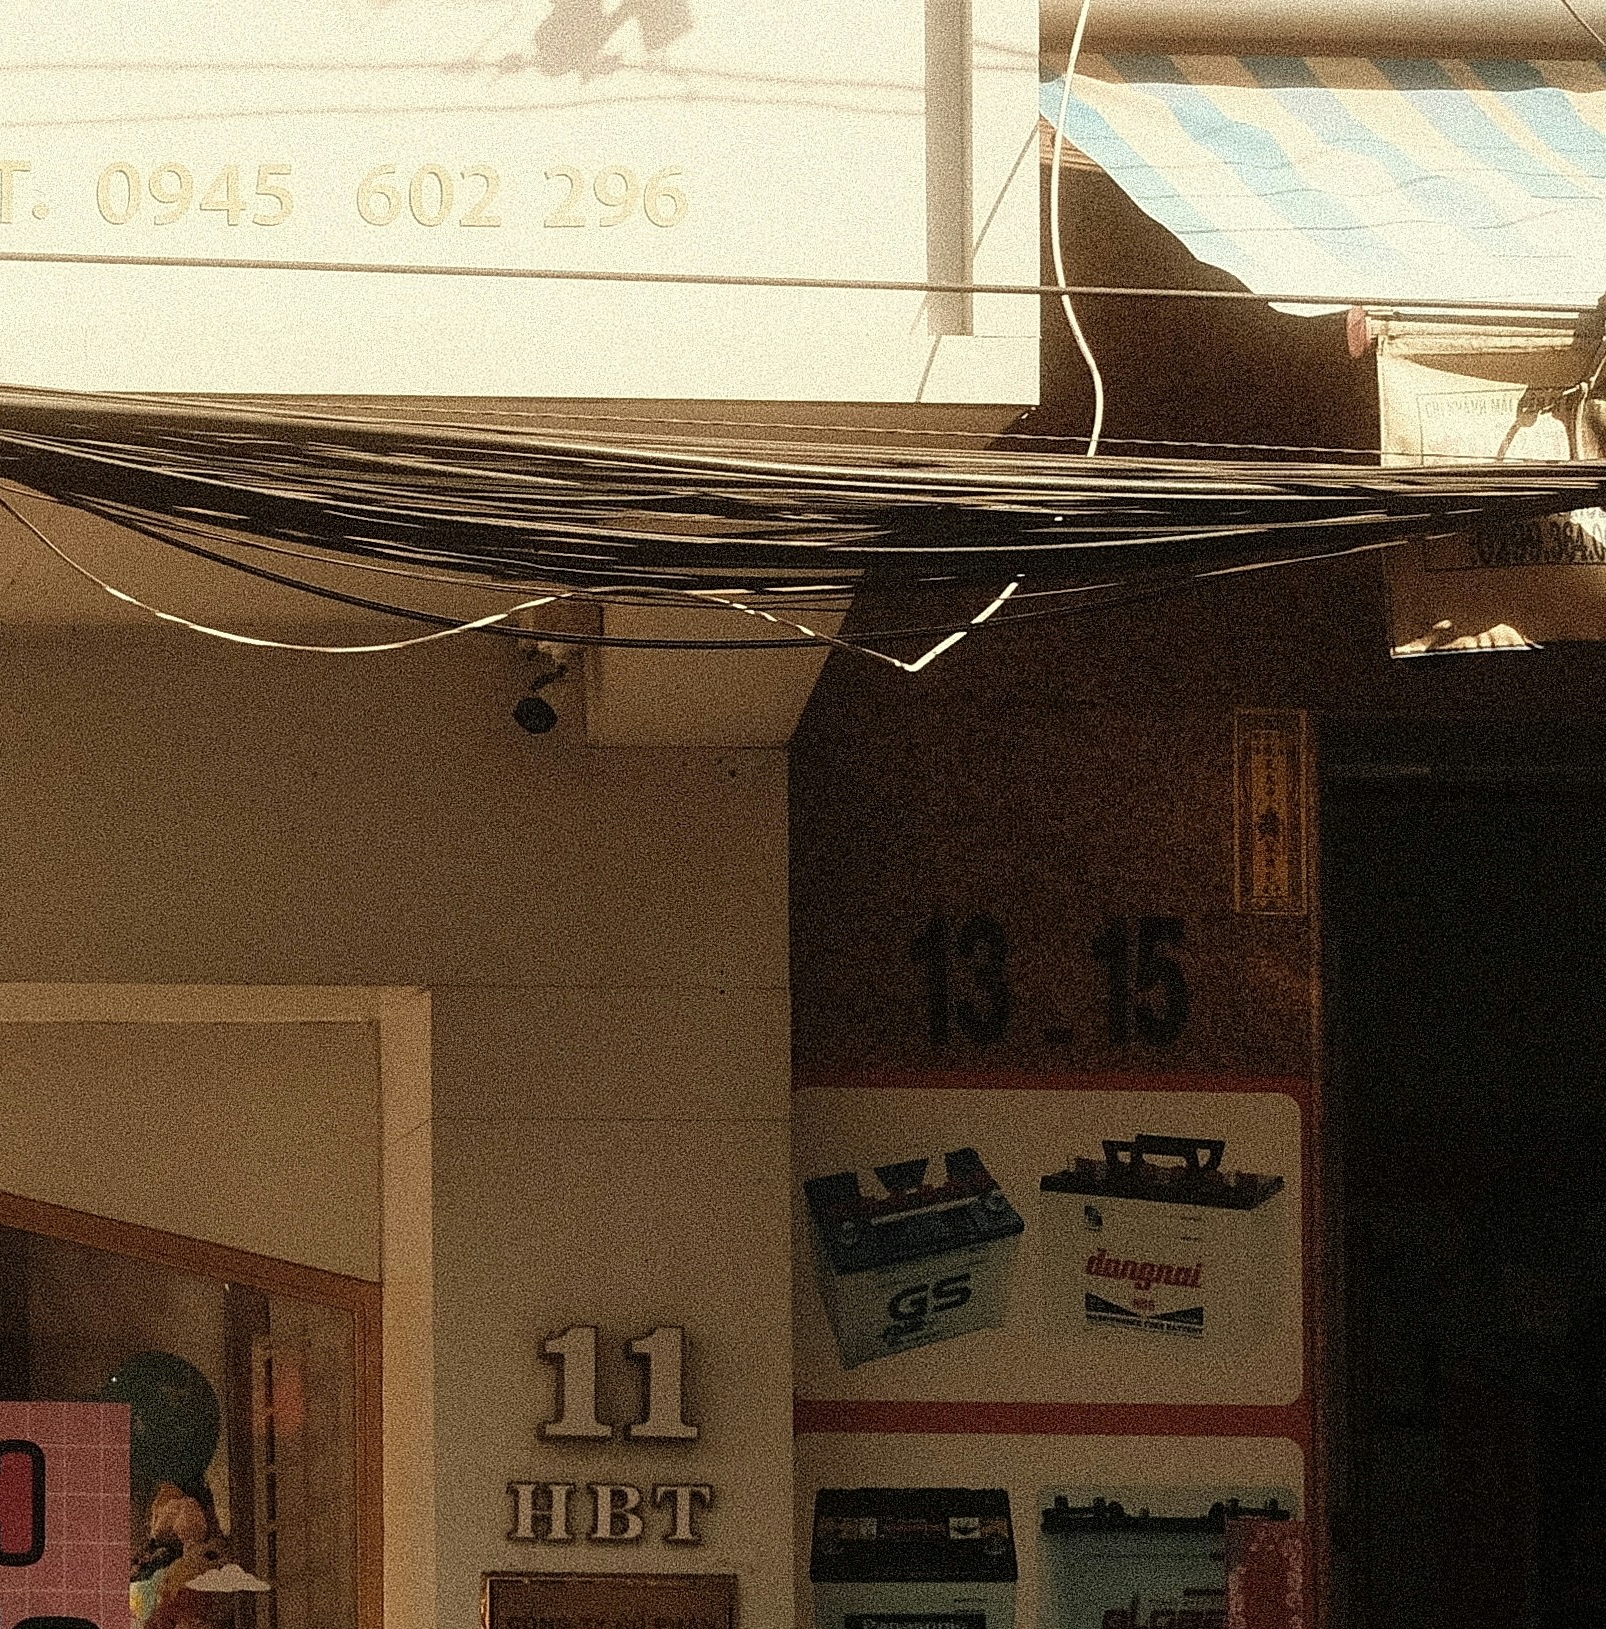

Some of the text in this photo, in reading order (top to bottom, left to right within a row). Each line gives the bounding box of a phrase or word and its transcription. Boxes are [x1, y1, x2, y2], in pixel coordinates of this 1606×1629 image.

[95, 161, 295, 228] 0945
[355, 163, 503, 229] 602
[542, 165, 690, 230] 296
[888, 1273, 971, 1320] GS
[538, 1325, 699, 1442] 11
[507, 1482, 713, 1544] HBT
